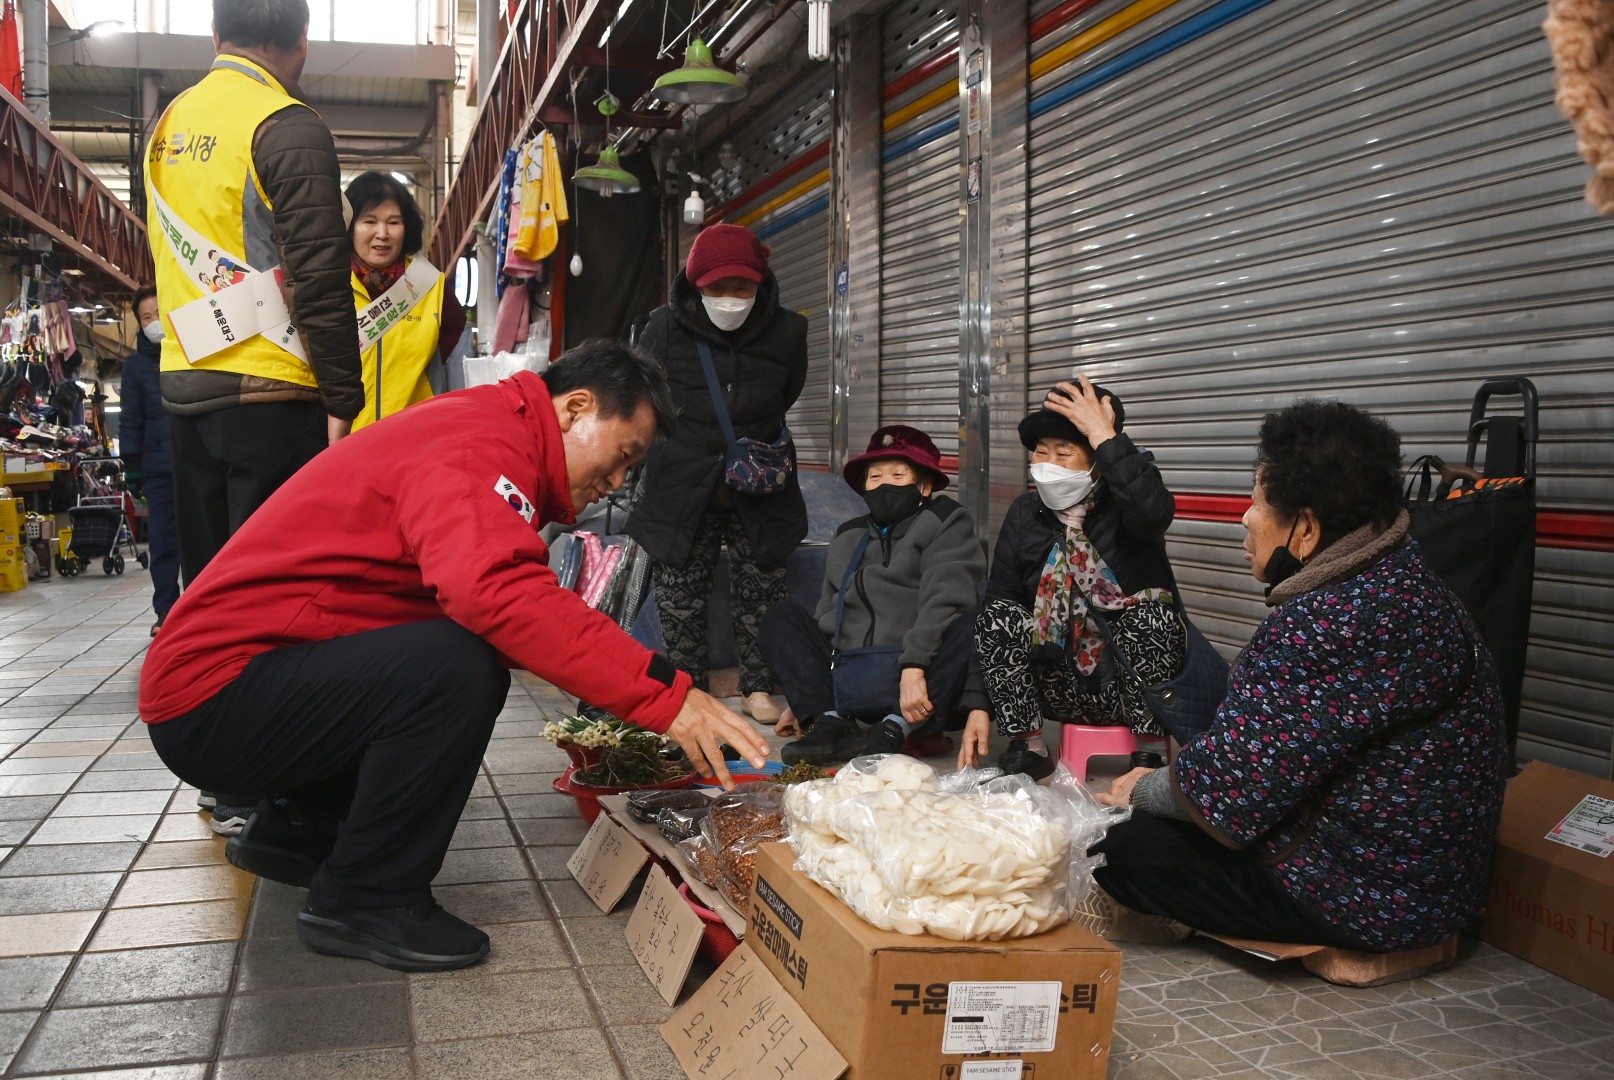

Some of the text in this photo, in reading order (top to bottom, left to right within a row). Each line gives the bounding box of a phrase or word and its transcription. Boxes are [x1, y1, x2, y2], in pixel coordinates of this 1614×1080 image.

[213, 308, 236, 343] 해운대구
[356, 296, 393, 330] 전통시
[363, 299, 409, 340] 시장에서
[784, 908, 801, 935] STICK
[1494, 880, 1577, 938] Thomas
[751, 902, 808, 990] 구운참마깨스틱
[716, 954, 754, 1007] 국산
[682, 1011, 721, 1075] 오천원
